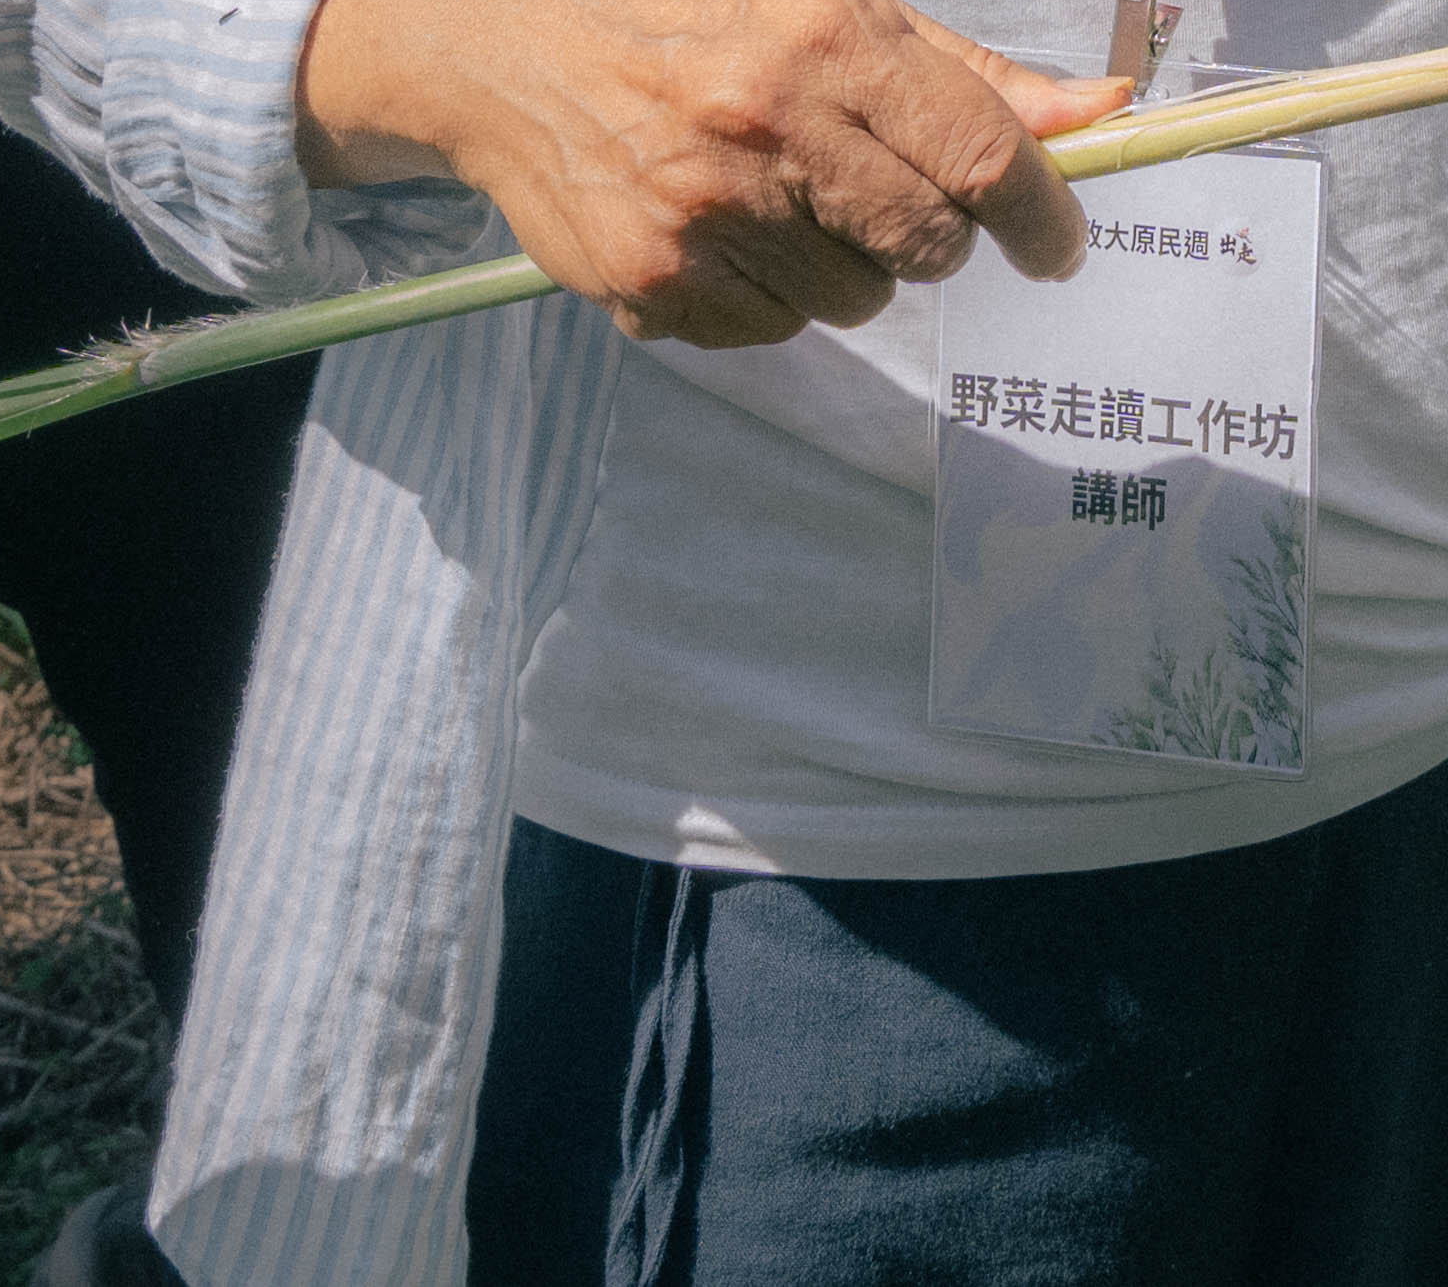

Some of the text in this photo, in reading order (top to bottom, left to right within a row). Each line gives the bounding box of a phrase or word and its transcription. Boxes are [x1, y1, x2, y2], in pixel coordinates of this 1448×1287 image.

[951, 372, 1298, 460] 野菜走讀工作坊
[1071, 468, 1167, 531] 講師
